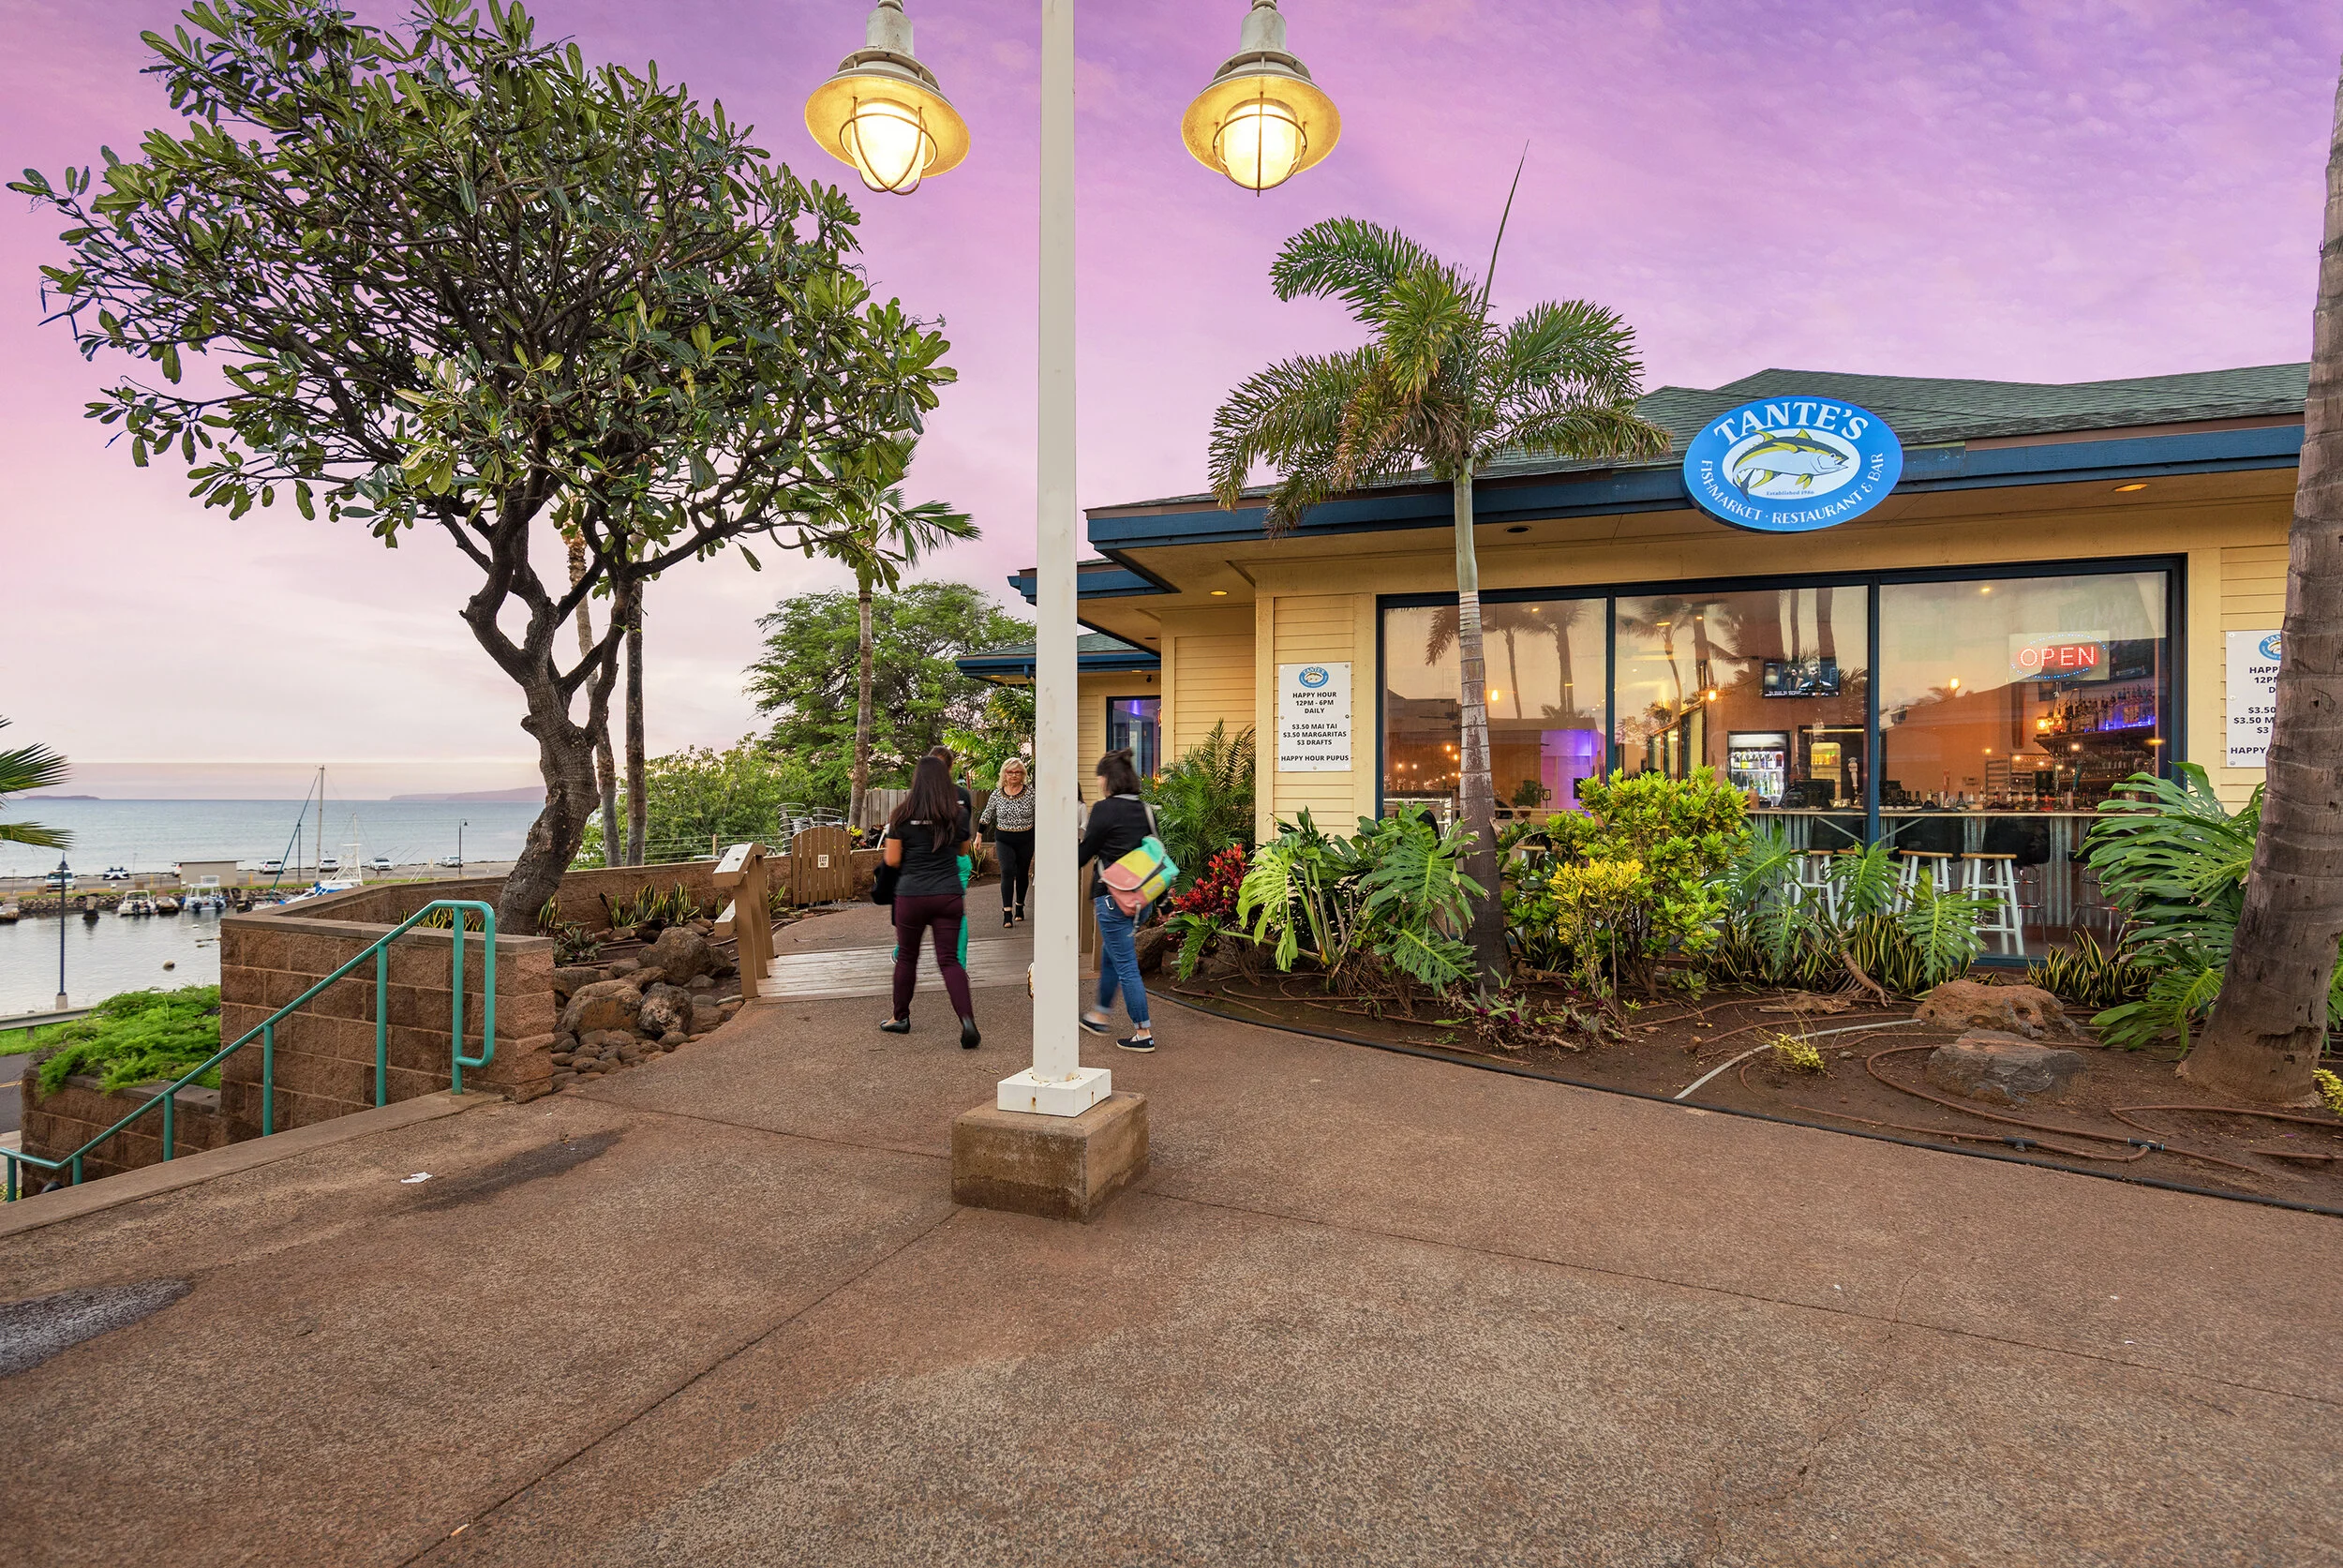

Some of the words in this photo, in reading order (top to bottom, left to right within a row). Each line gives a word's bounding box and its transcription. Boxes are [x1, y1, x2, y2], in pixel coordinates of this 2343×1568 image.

[1713, 401, 1869, 446] TANTE'S
[1700, 459, 1763, 521] FISHMARKET
[1771, 490, 1863, 524] RESTAURANT
[1860, 482, 1873, 494] &
[1867, 453, 1884, 483] BAR
[2020, 646, 2096, 666] OPEN
[2233, 716, 2261, 724] $3.50
[2231, 746, 2266, 754] HAPPY
